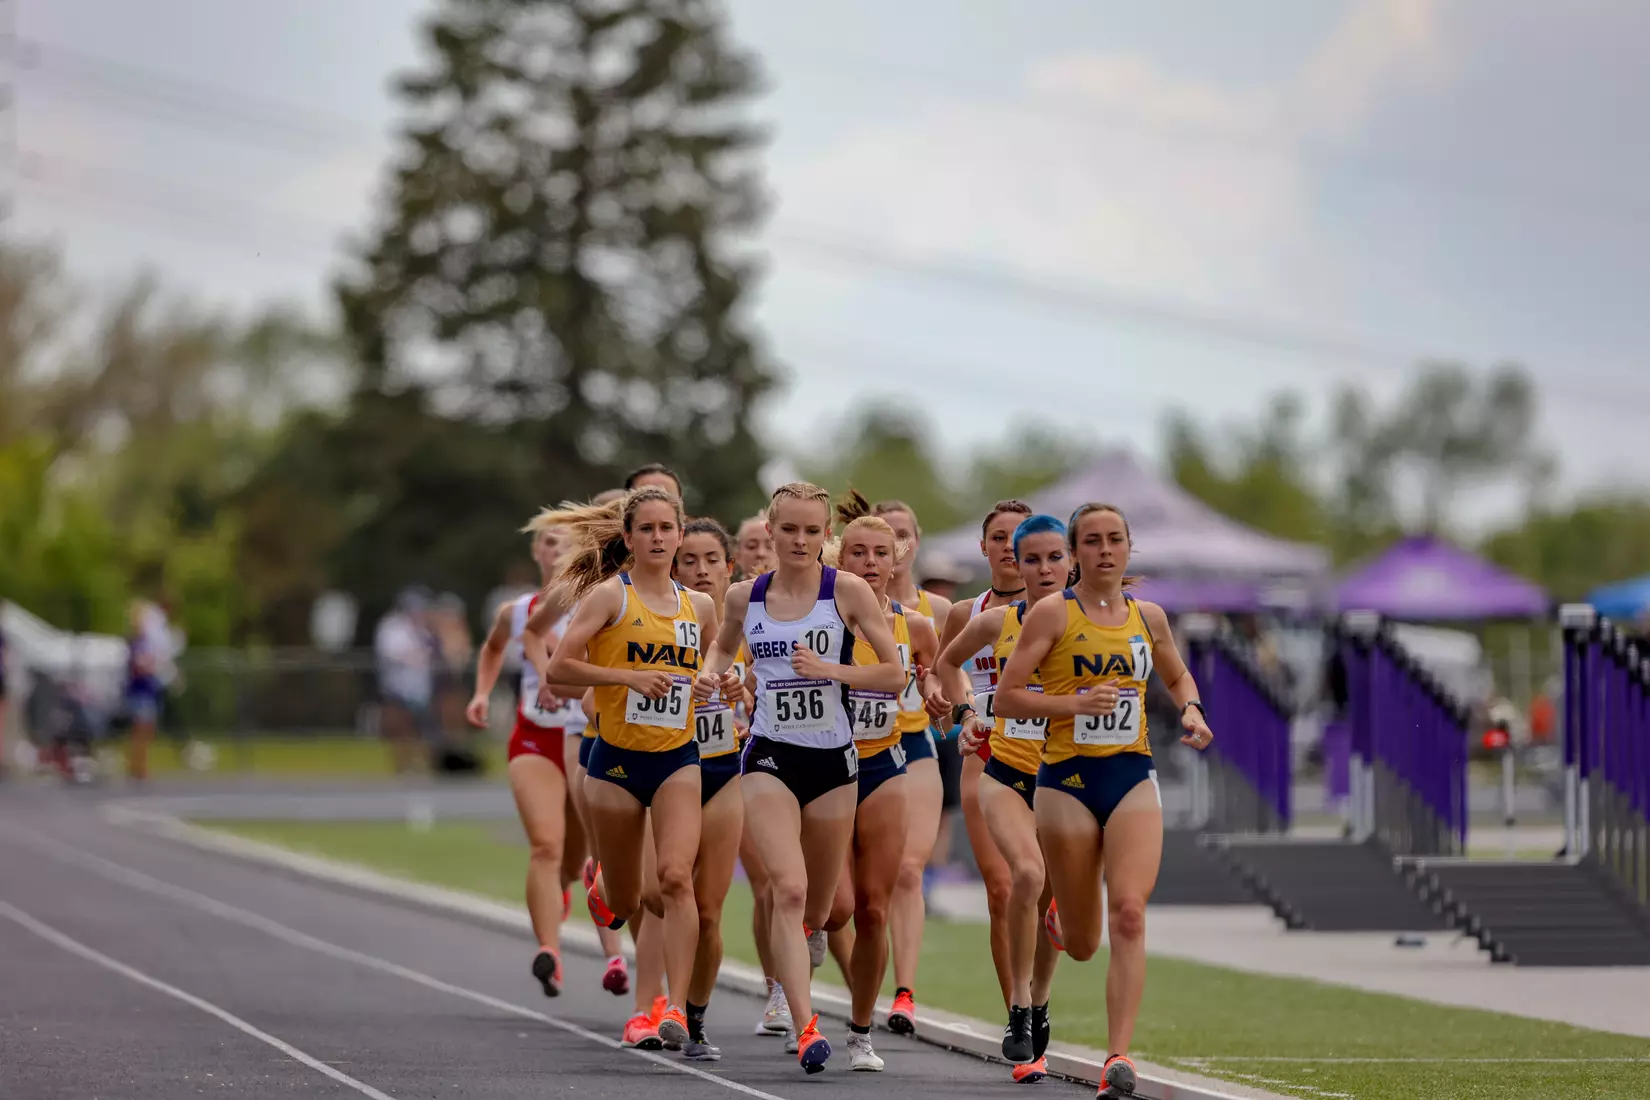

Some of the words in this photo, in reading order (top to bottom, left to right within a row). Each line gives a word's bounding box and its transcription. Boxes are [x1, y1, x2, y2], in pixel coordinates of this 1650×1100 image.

[679, 622, 697, 647] 15
[804, 629, 829, 655] 10
[627, 641, 698, 670] NAU
[749, 641, 788, 659] WEBER
[1139, 645, 1147, 679] 1
[1072, 654, 1136, 677] NA
[637, 685, 682, 715] 365
[775, 689, 824, 722] 536
